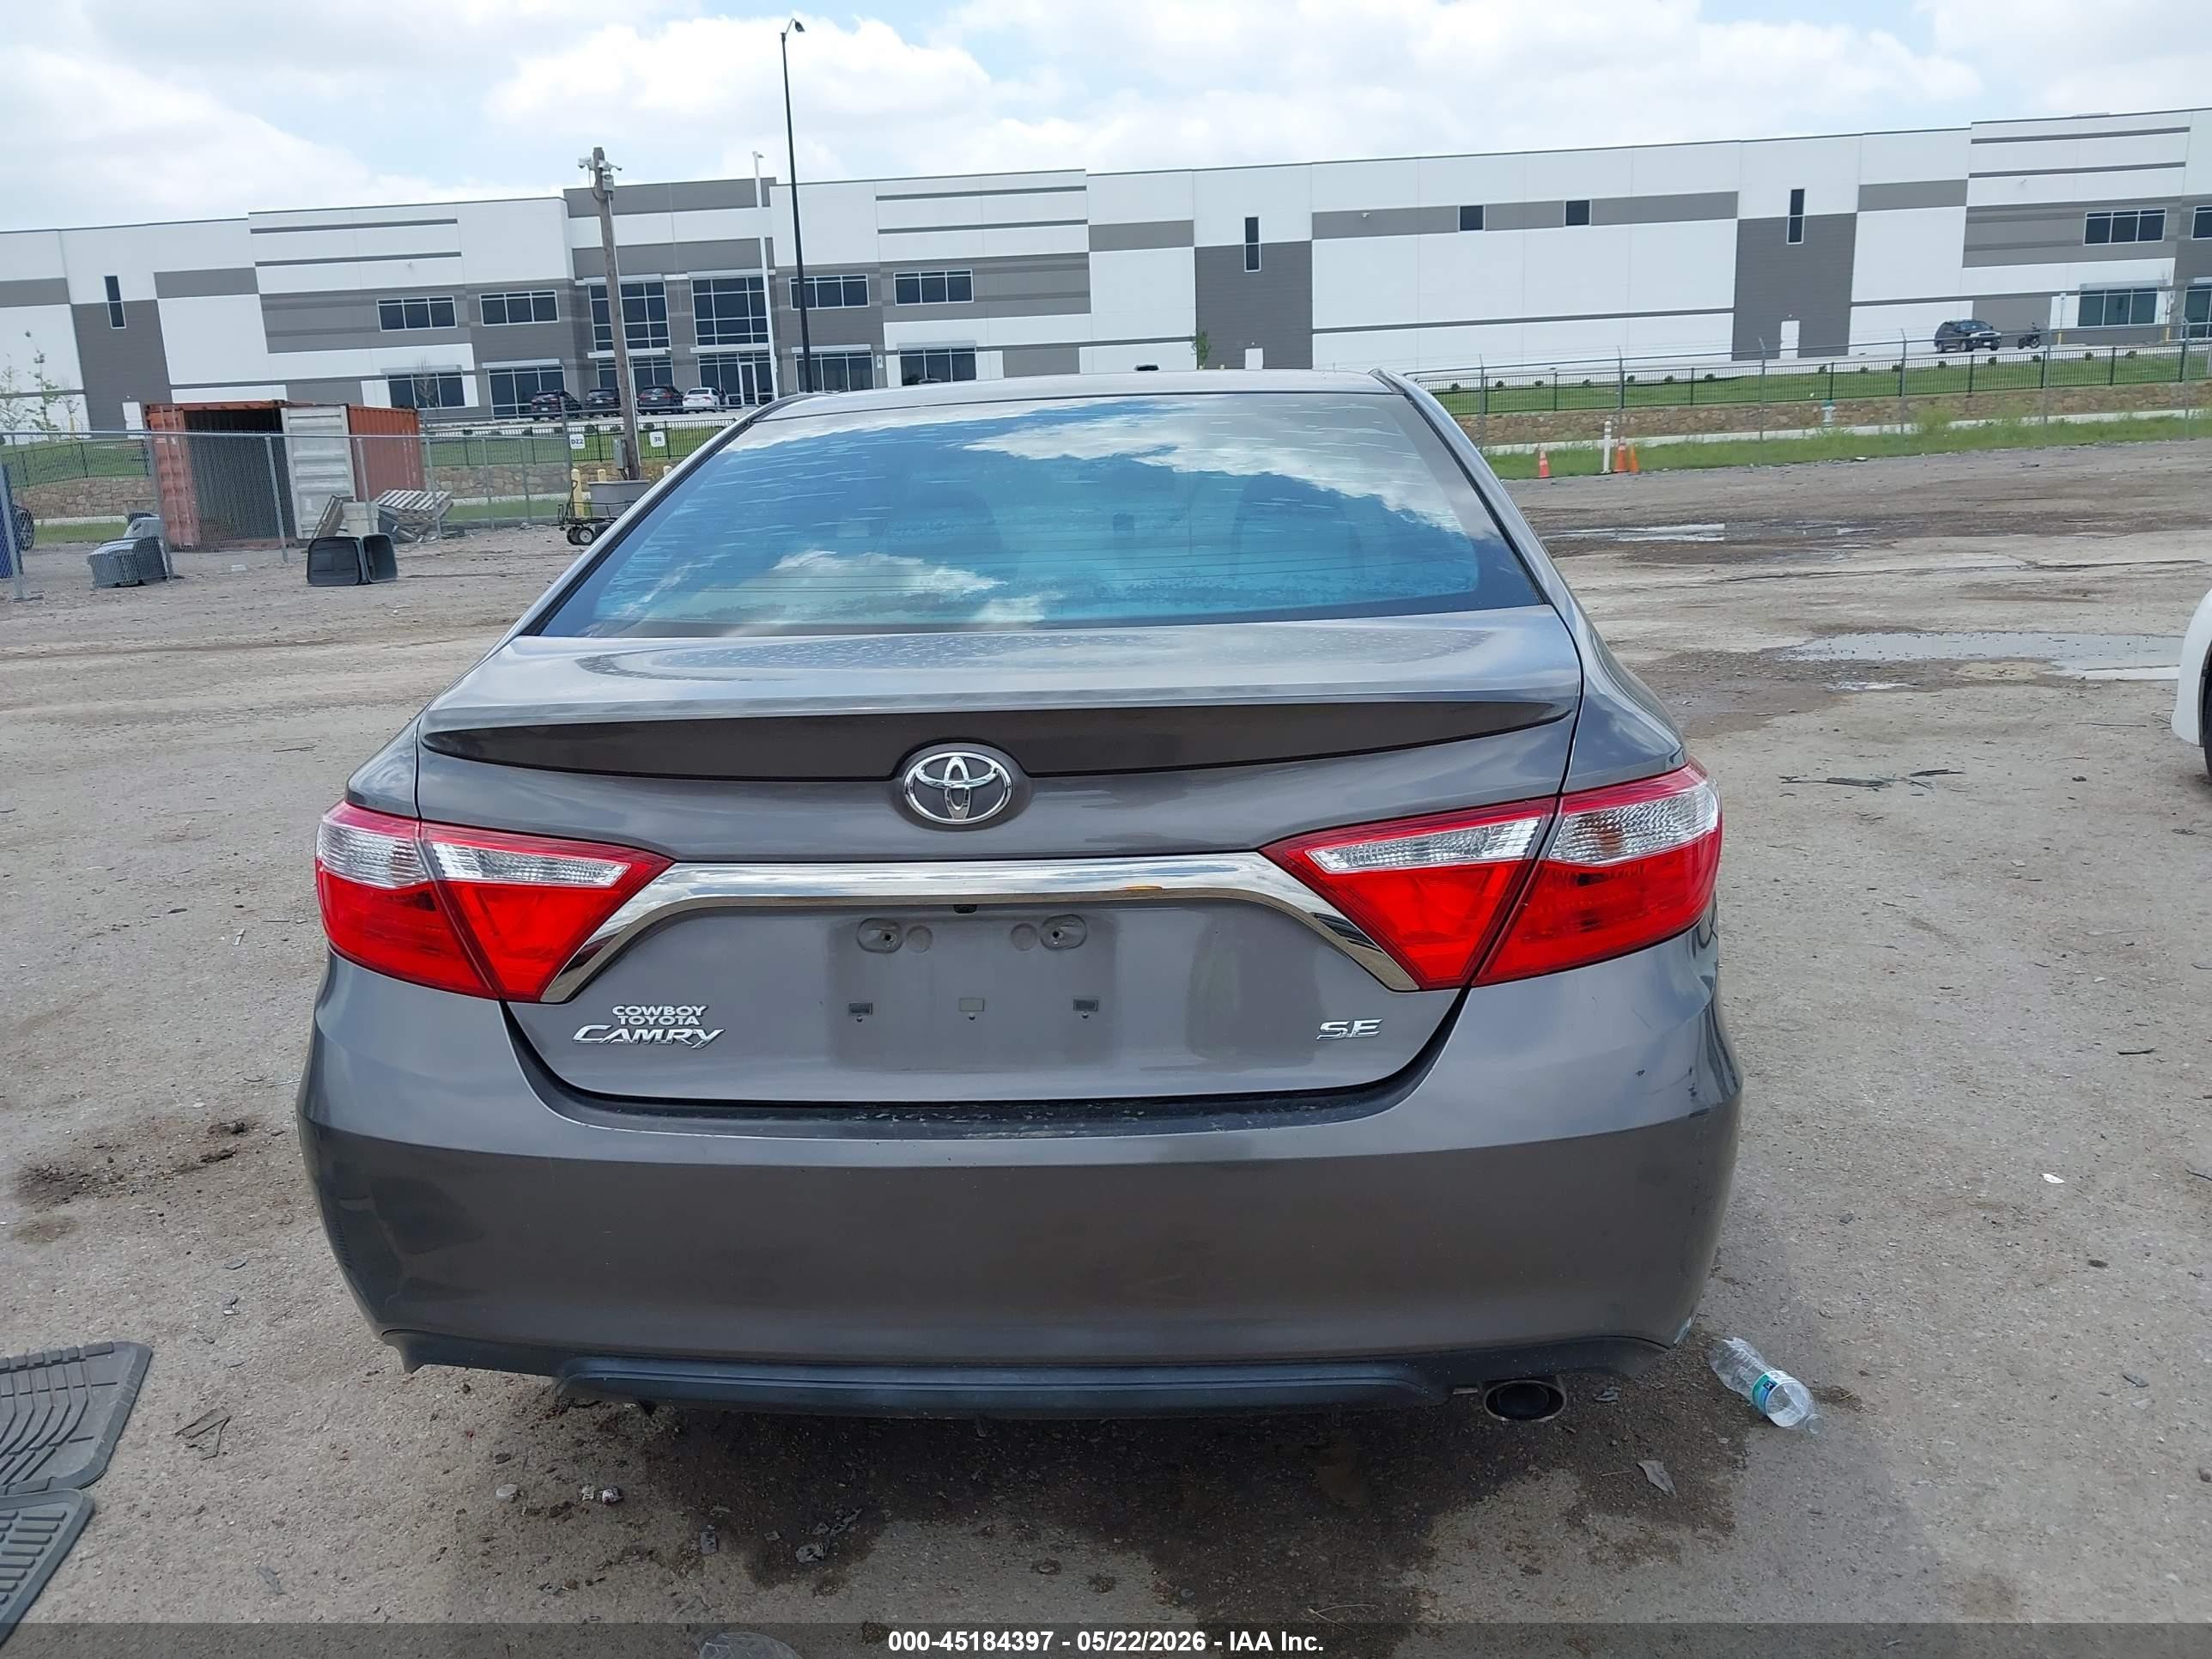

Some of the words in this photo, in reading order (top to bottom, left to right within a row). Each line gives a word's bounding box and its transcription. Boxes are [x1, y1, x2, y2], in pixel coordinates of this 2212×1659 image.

[611, 1005, 708, 1016] COWBOY
[617, 1016, 701, 1025] TOYOTA
[572, 1024, 726, 1048] CAMRY
[1316, 1018, 1383, 1040] SE
